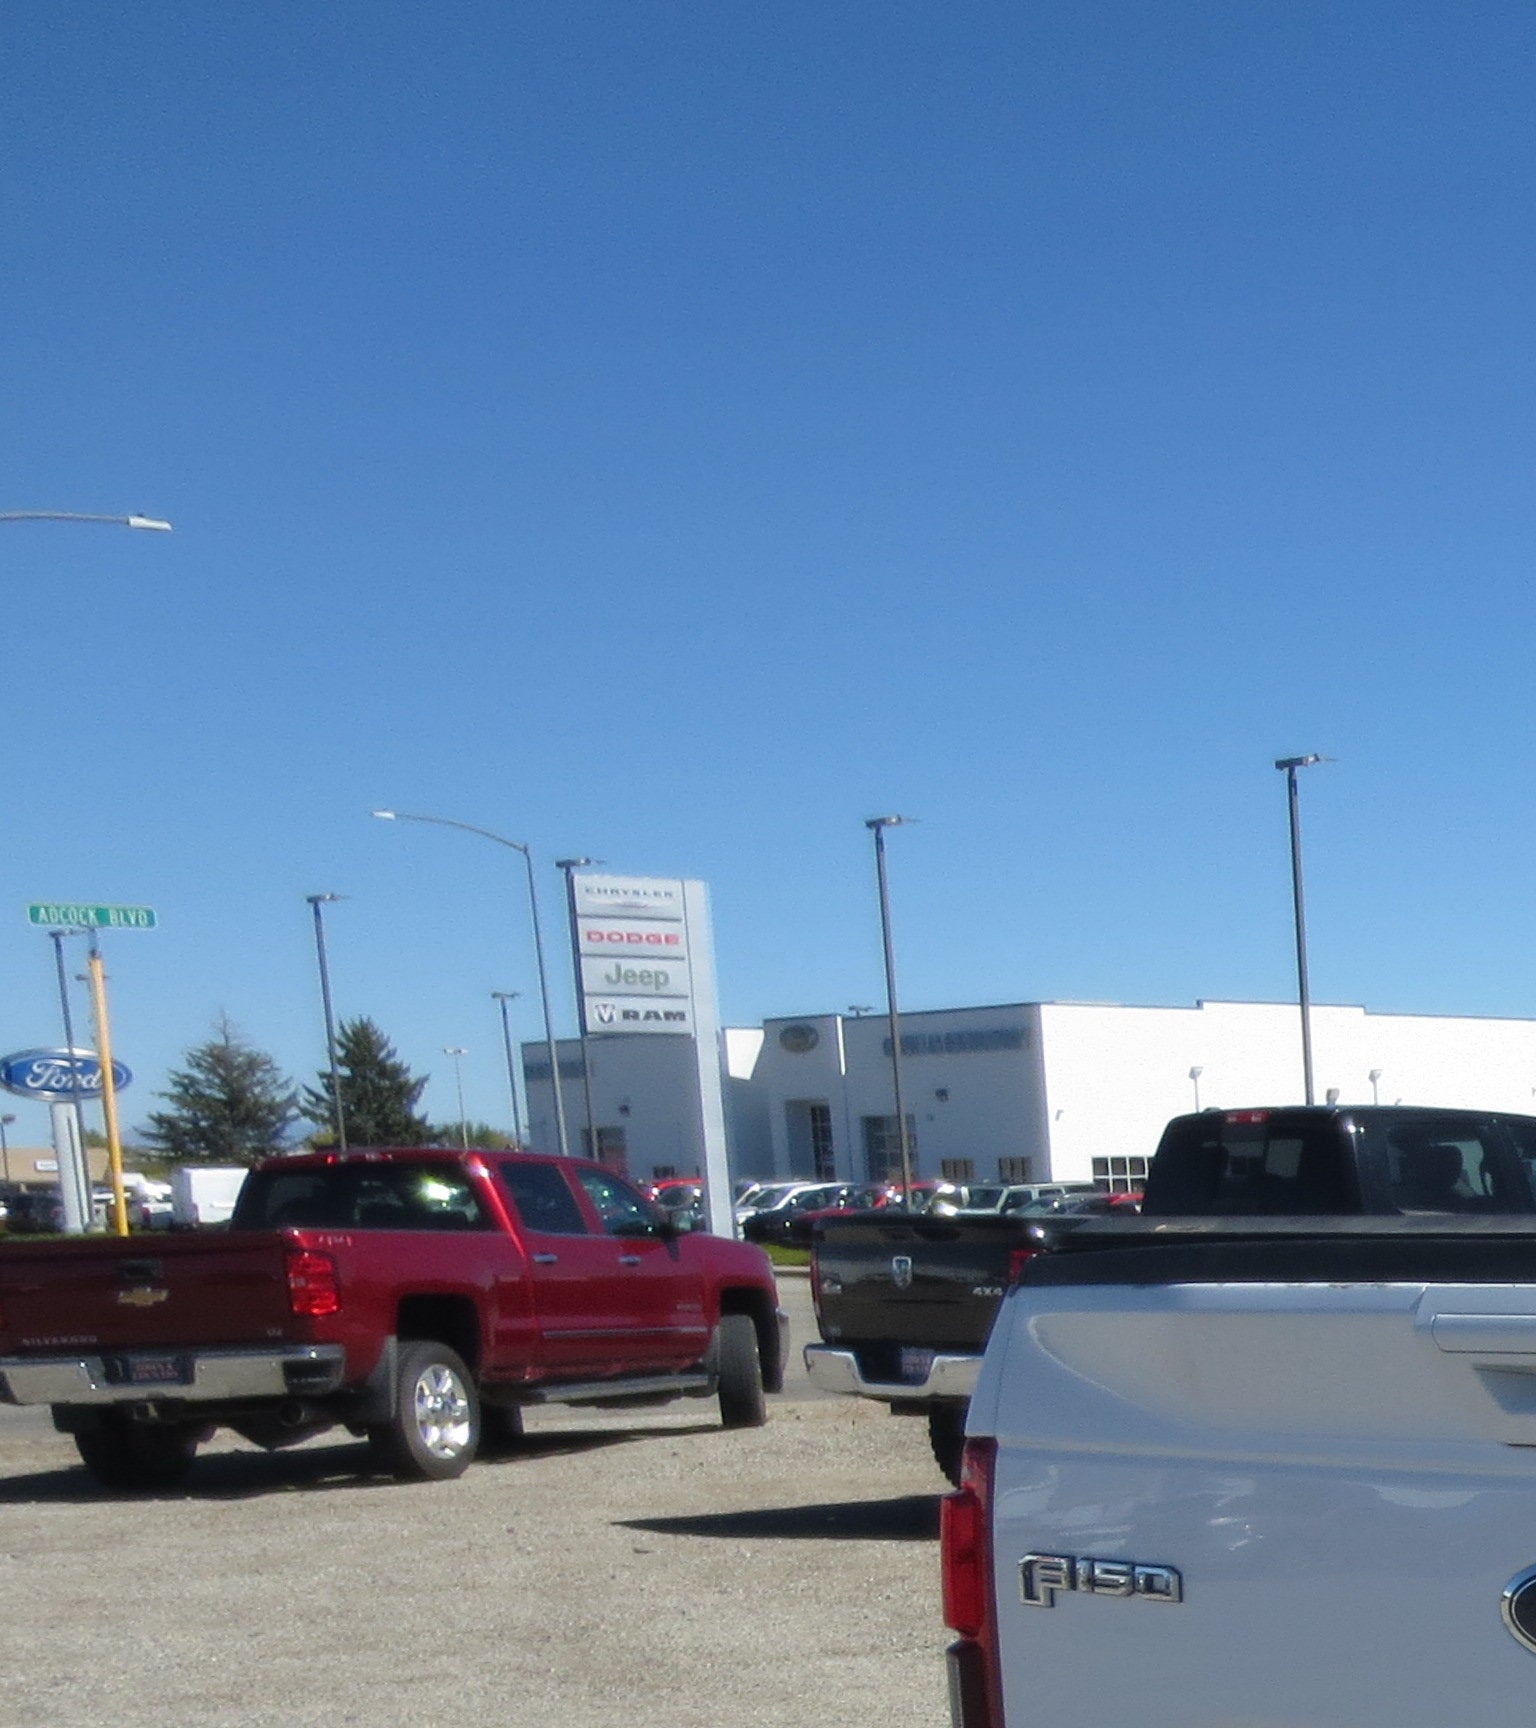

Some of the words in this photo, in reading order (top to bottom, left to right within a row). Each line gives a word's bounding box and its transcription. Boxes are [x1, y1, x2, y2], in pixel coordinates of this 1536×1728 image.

[585, 886, 673, 898] CHRYSLER
[40, 906, 98, 925] ADCOCK
[109, 909, 147, 925] BLVD
[586, 930, 680, 945] DODGE
[604, 963, 670, 991] Jeep
[622, 1009, 686, 1021] RAM
